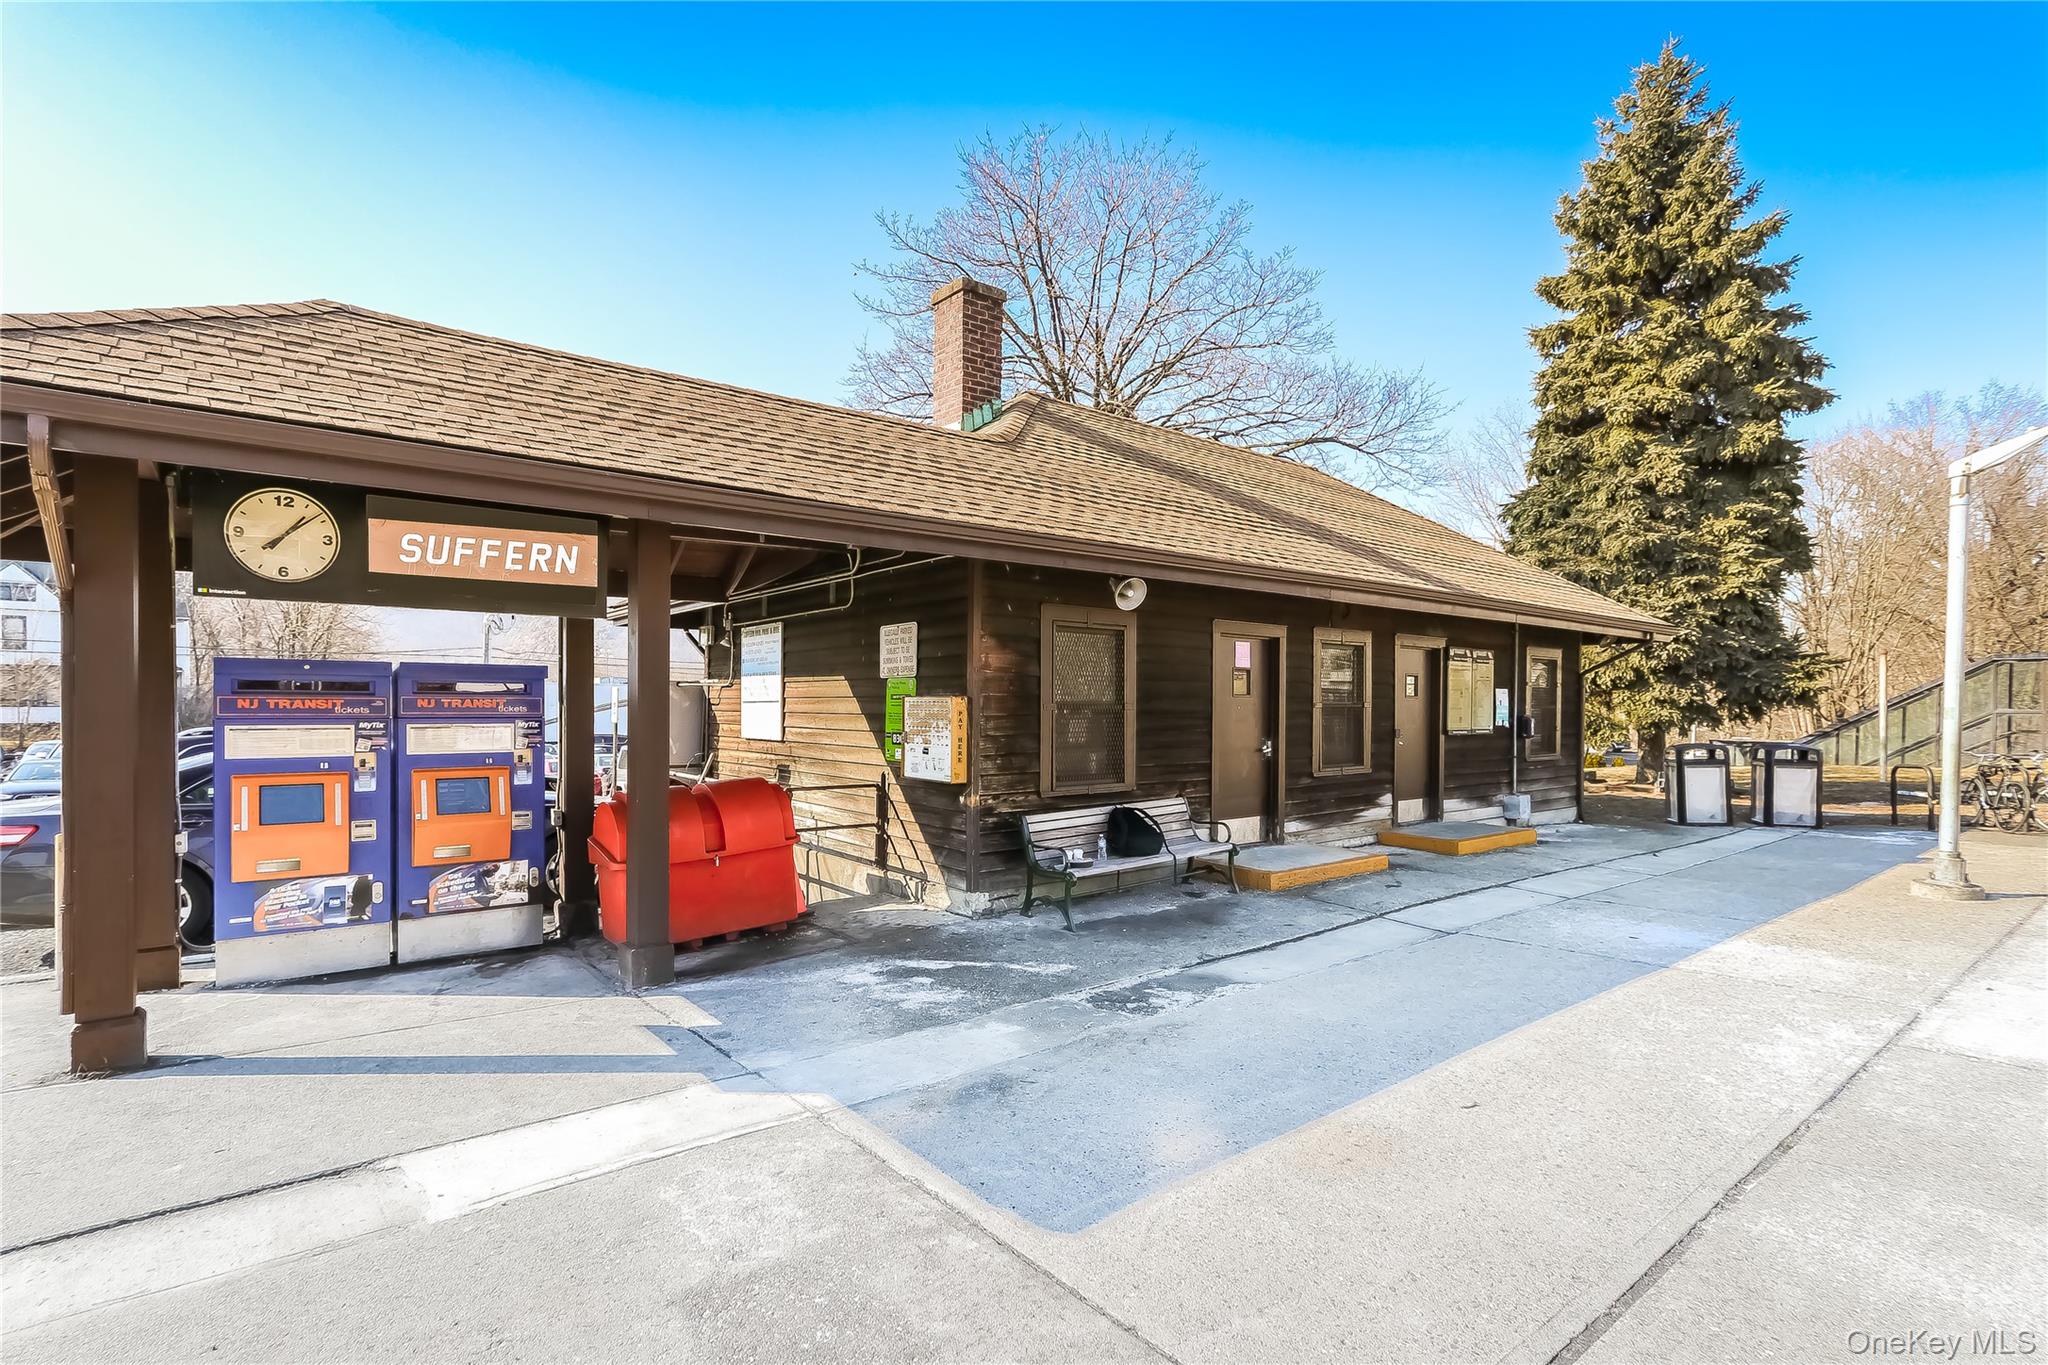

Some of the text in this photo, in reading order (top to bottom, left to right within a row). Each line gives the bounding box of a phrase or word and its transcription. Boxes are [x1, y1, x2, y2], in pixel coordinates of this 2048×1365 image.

[274, 495, 295, 508] 12
[232, 525, 245, 538] 9
[322, 534, 334, 546] 3
[399, 532, 579, 575] SUFFERN
[277, 566, 290, 578] 6
[236, 698, 345, 709] NJ TRANSIT
[334, 705, 370, 714] tickets
[416, 698, 507, 709] NJ TRANSIT
[498, 704, 528, 713] tickets
